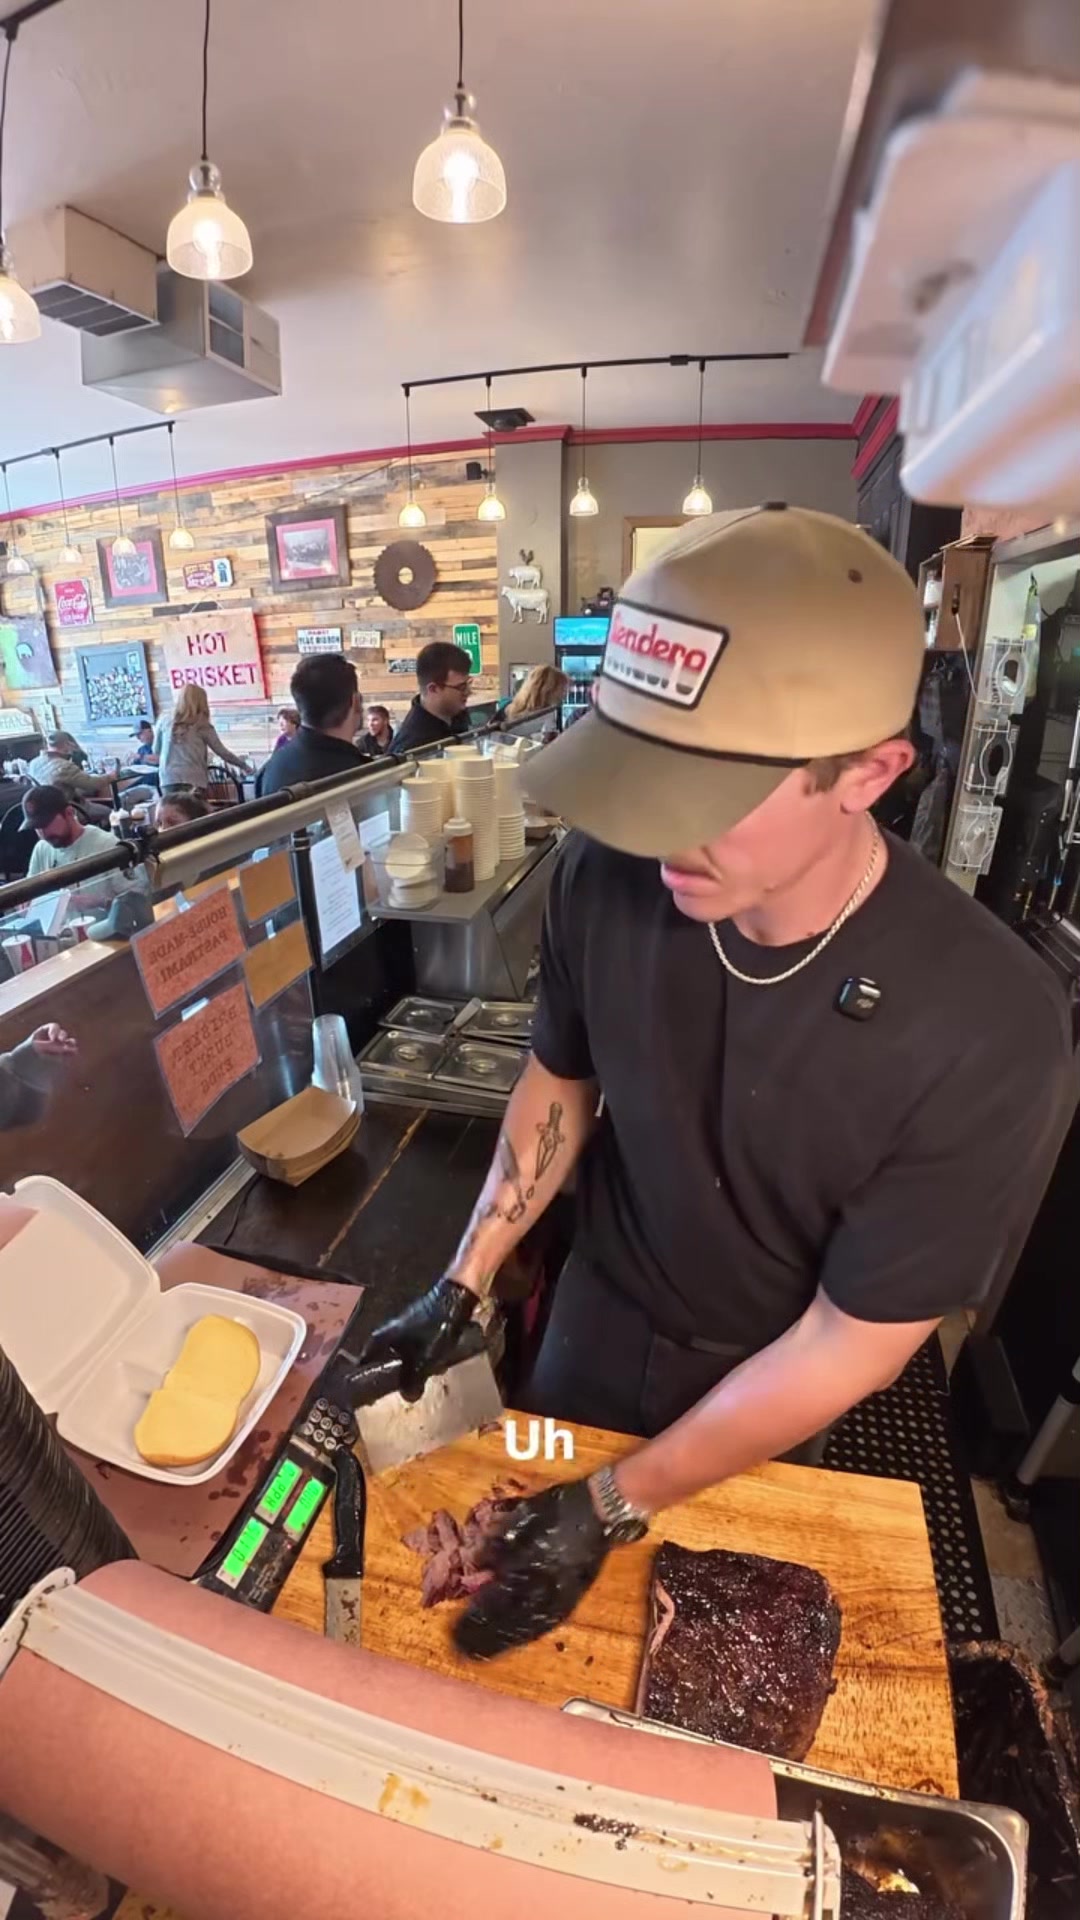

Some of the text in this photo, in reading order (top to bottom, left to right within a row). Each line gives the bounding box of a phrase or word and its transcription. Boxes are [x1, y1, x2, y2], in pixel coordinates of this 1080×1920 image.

[187, 632, 228, 656] HOT
[456, 631, 478, 648] MILE
[170, 662, 257, 690] BRISKET
